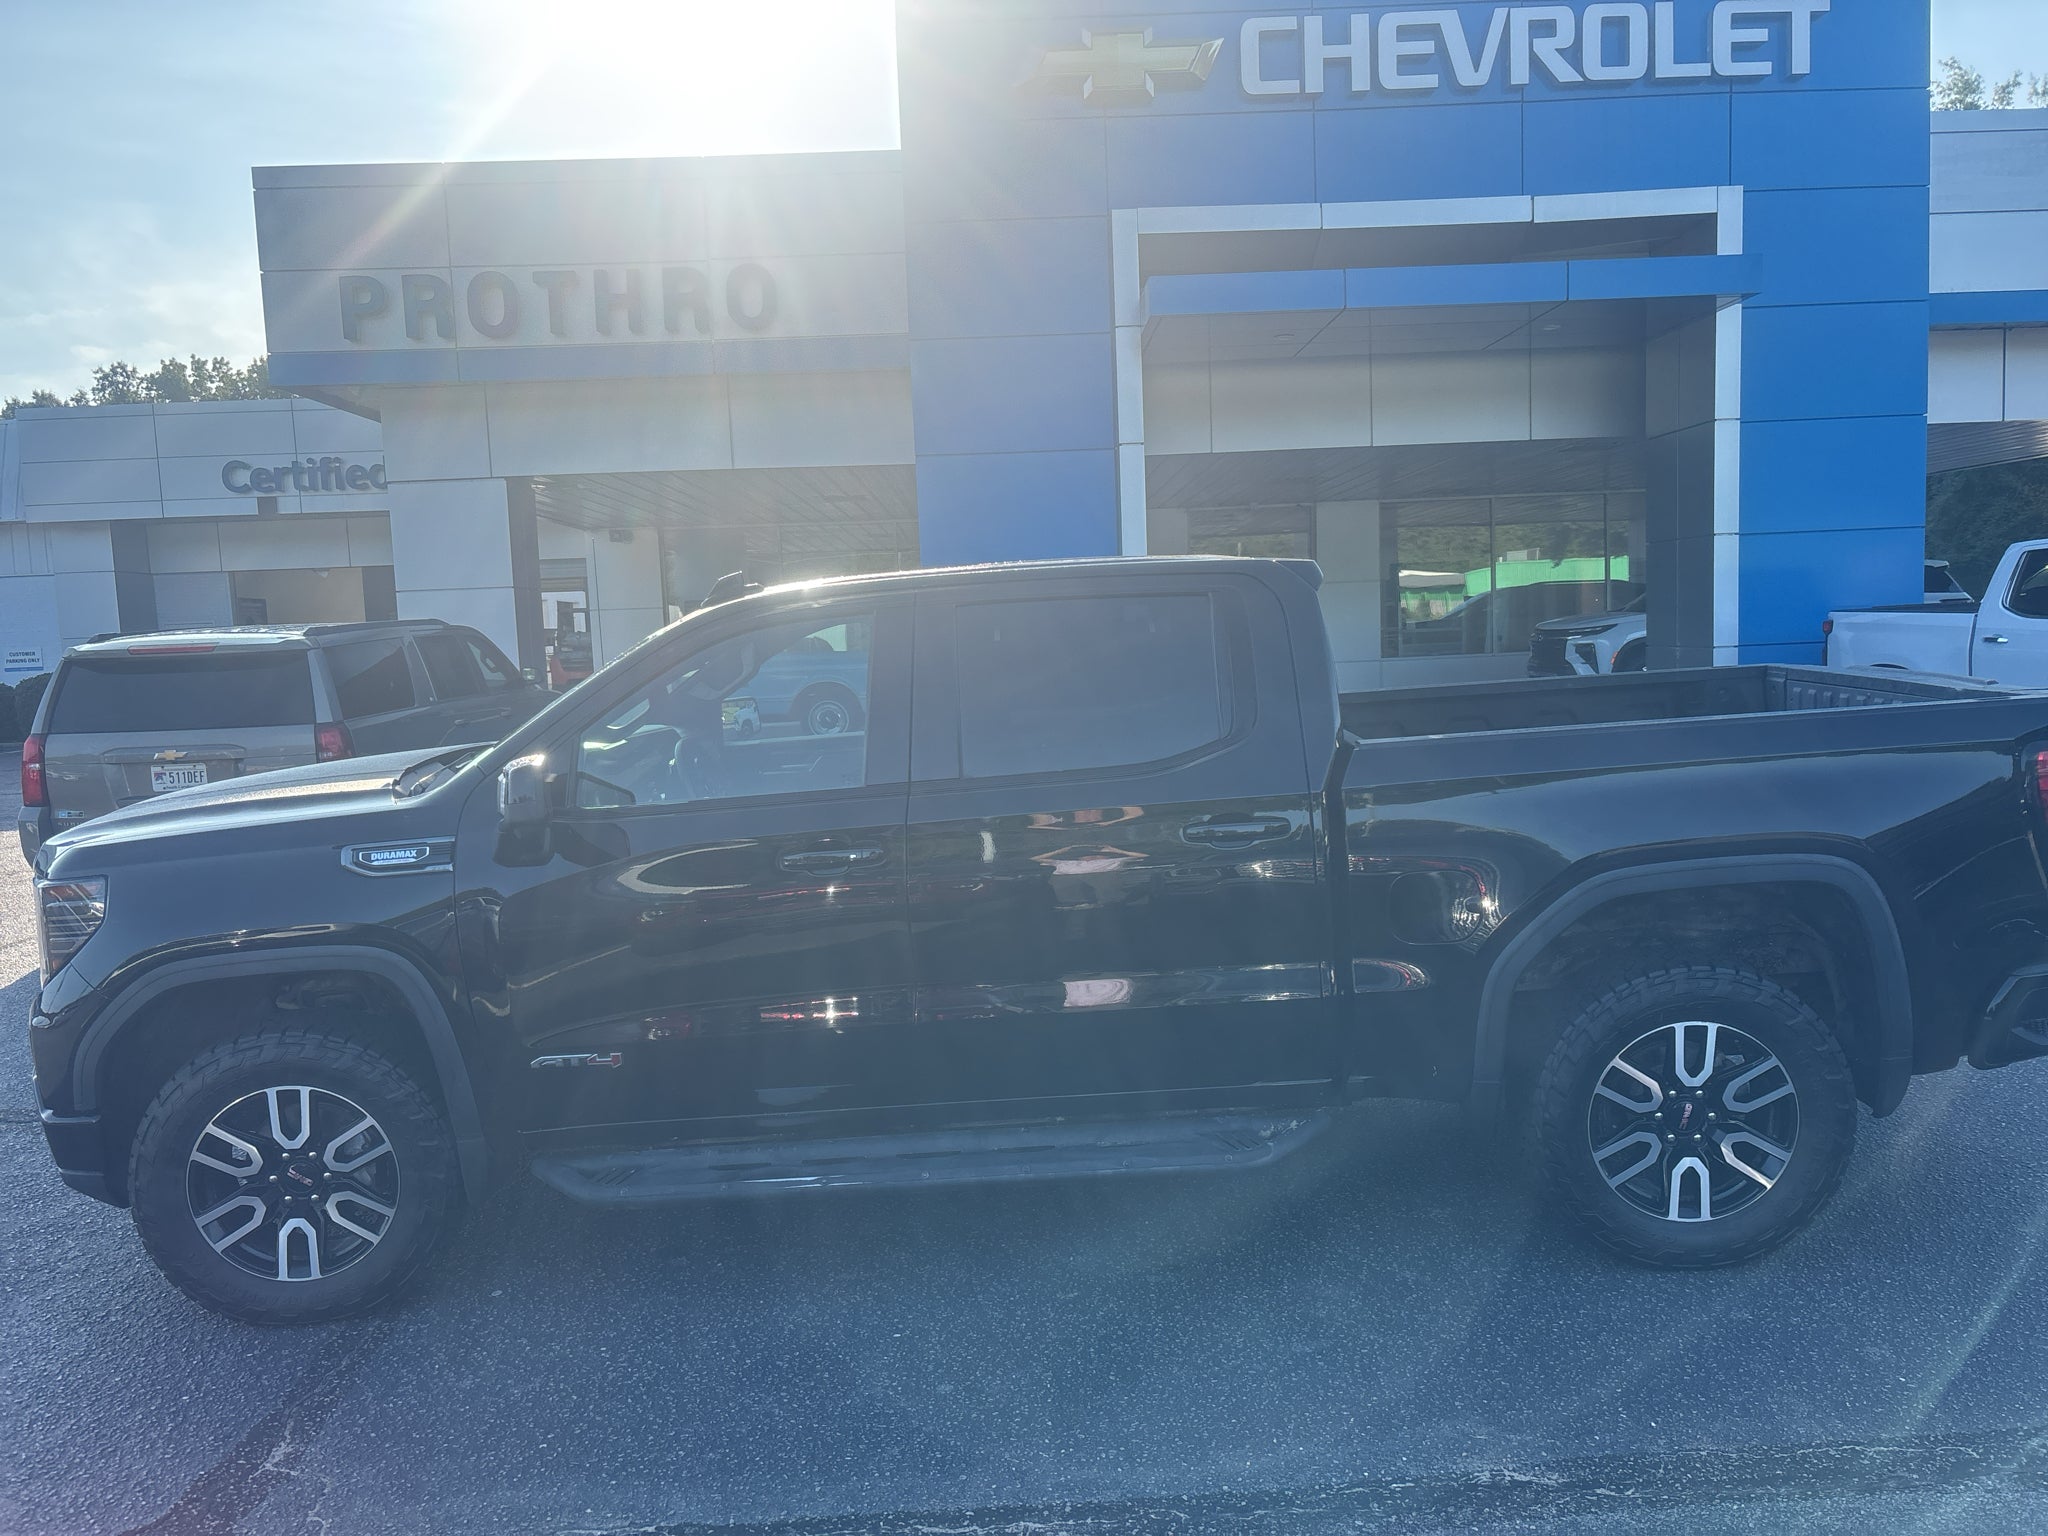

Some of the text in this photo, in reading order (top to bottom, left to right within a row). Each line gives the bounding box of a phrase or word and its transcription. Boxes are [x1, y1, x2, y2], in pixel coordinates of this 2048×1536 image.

[1240, 0, 1831, 97] CHEVROLET
[339, 263, 778, 343] PROTHRO
[168, 770, 205, 784] 511DEF
[370, 849, 418, 861] DURAMAX
[530, 1052, 623, 1069] AT4
